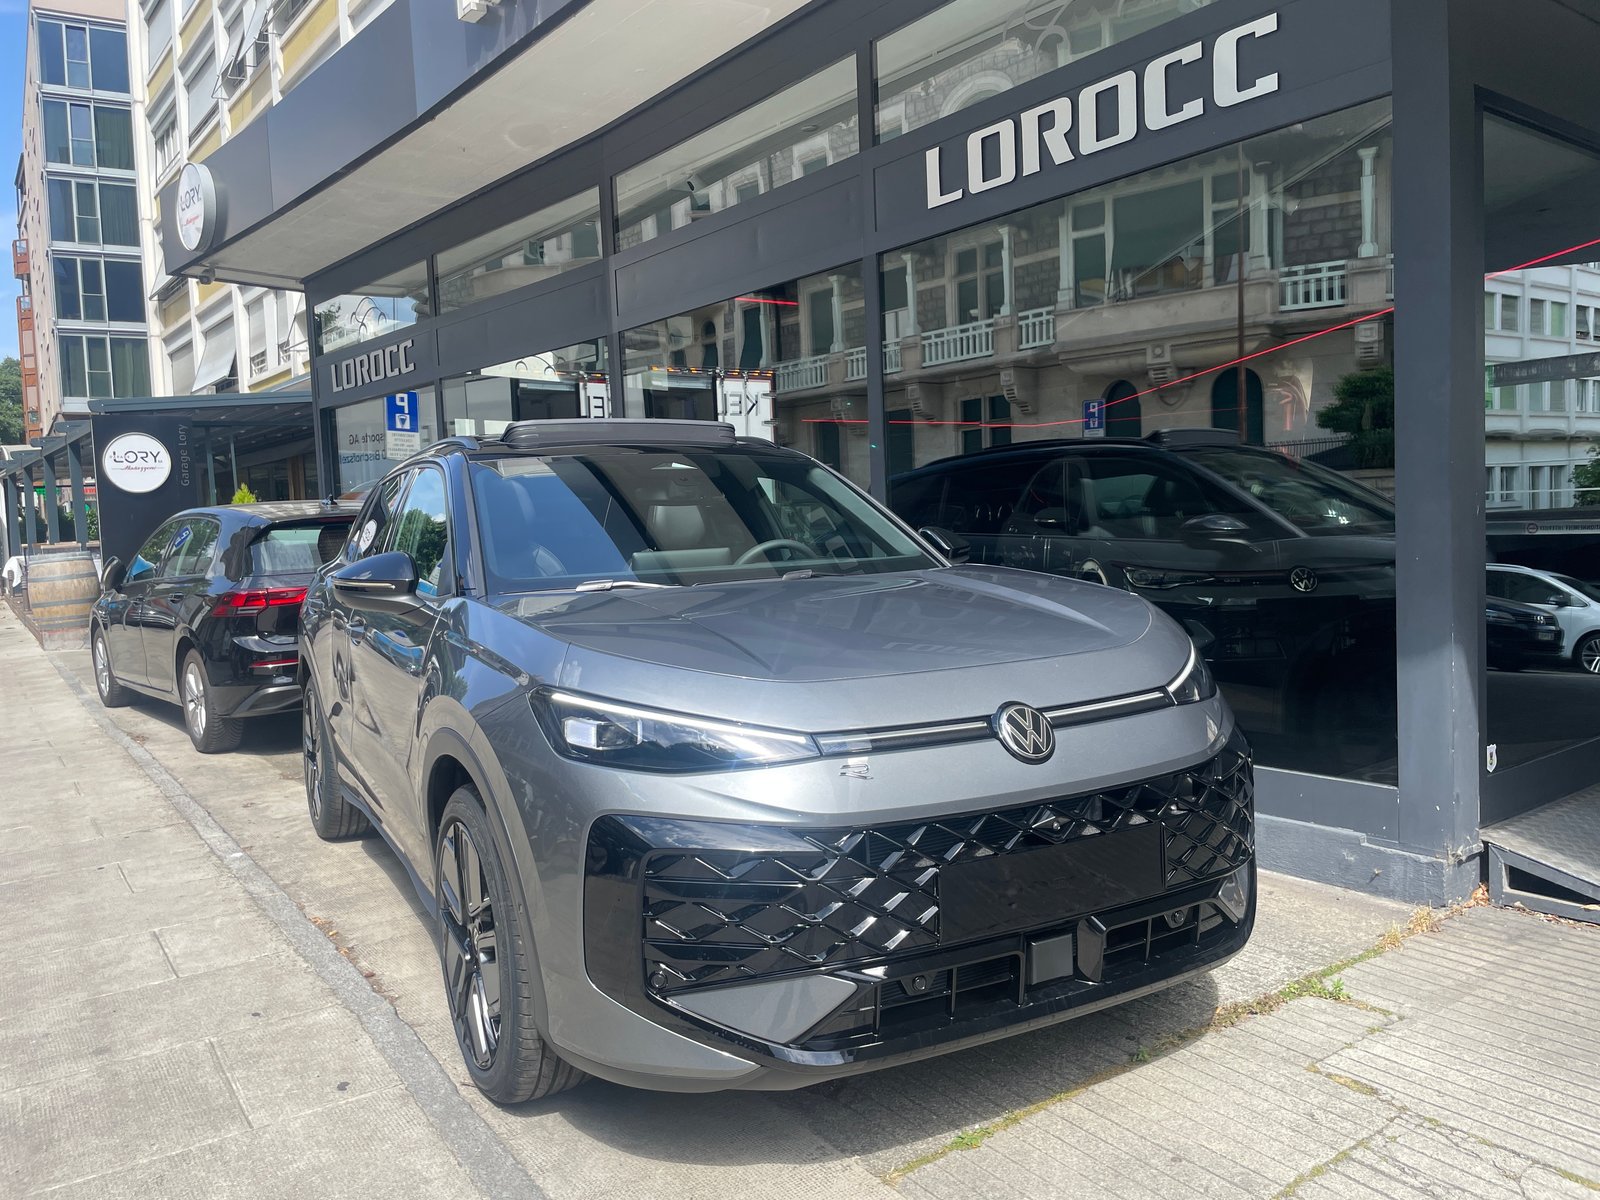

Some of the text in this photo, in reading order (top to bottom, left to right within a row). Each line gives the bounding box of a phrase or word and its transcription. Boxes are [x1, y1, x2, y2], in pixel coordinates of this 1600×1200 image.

[925, 12, 1279, 210] LOROCC
[180, 184, 201, 212] LORY
[331, 339, 415, 393] LOROCC
[112, 451, 161, 463] LORY
[178, 424, 191, 487] Garage Lory
